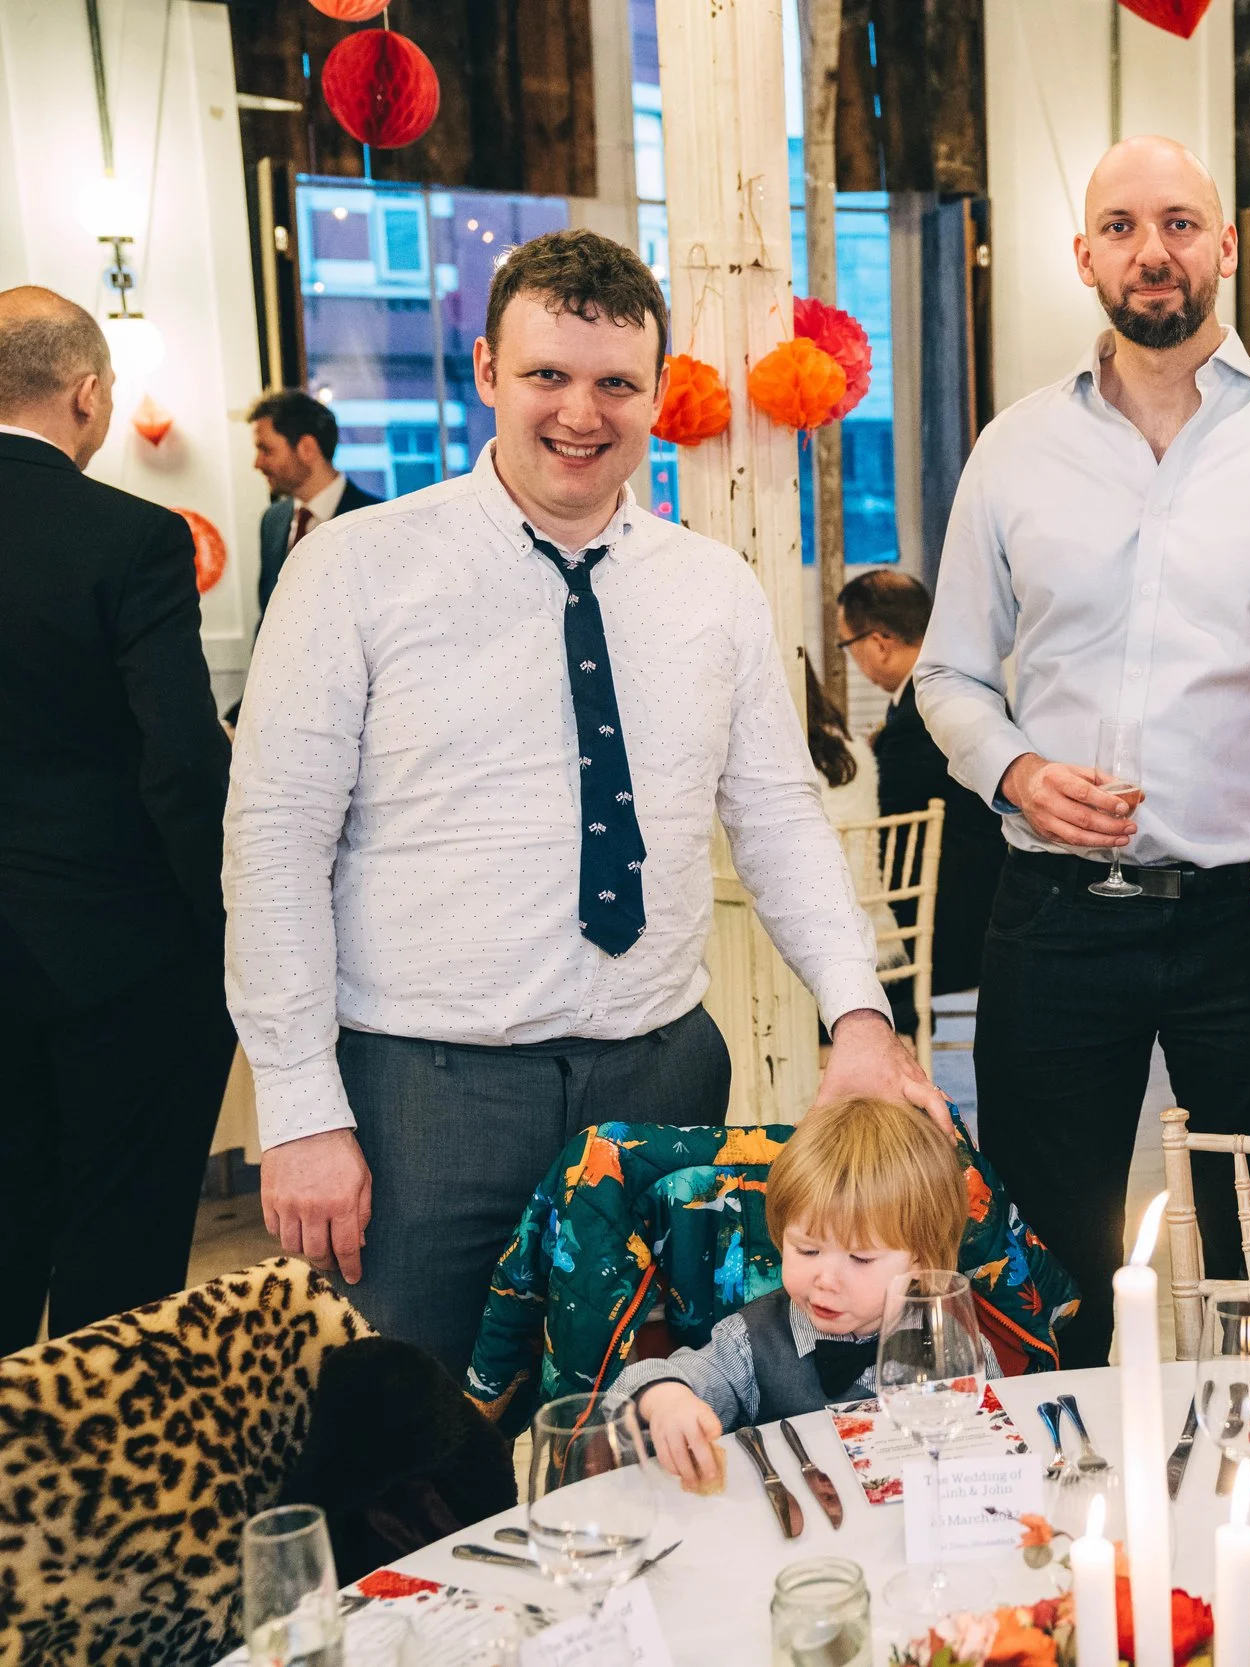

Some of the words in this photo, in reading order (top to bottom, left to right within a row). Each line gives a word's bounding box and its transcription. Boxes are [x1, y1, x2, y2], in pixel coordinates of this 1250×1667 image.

[951, 1470, 1007, 1484] Wedding
[1008, 1468, 1022, 1481] of
[940, 1485, 967, 1500] inh
[969, 1485, 978, 1497] &
[981, 1483, 1013, 1496] John
[948, 1511, 990, 1527] March
